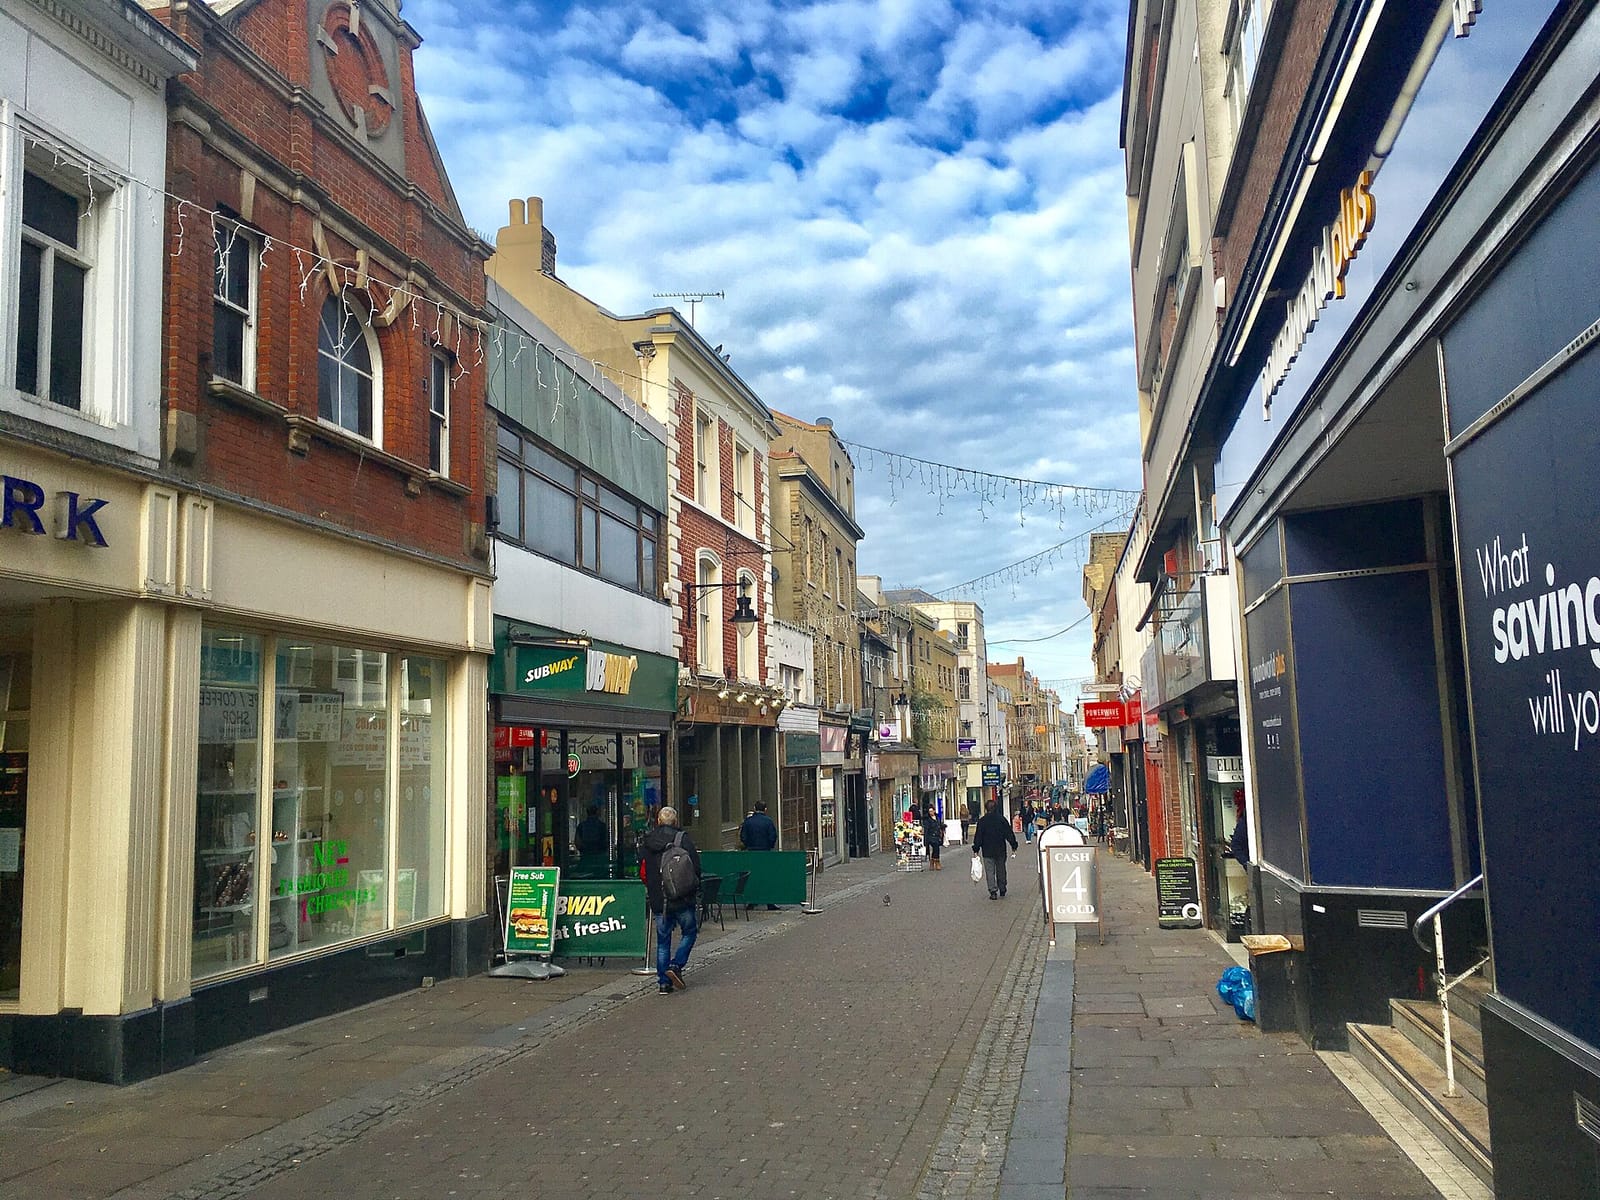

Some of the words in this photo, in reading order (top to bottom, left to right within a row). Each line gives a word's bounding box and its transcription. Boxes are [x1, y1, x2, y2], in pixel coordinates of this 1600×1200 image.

[1476, 533, 1530, 599] What
[525, 656, 579, 683] SUBWAY
[1085, 708, 1120, 717] POWERWAVE
[1528, 668, 1565, 735] will
[1568, 690, 1600, 751] yo
[1054, 852, 1090, 862] CASH
[513, 871, 529, 880] Free
[530, 871, 545, 880] Sub
[1061, 866, 1087, 901] 4
[1056, 904, 1095, 914] GOLD
